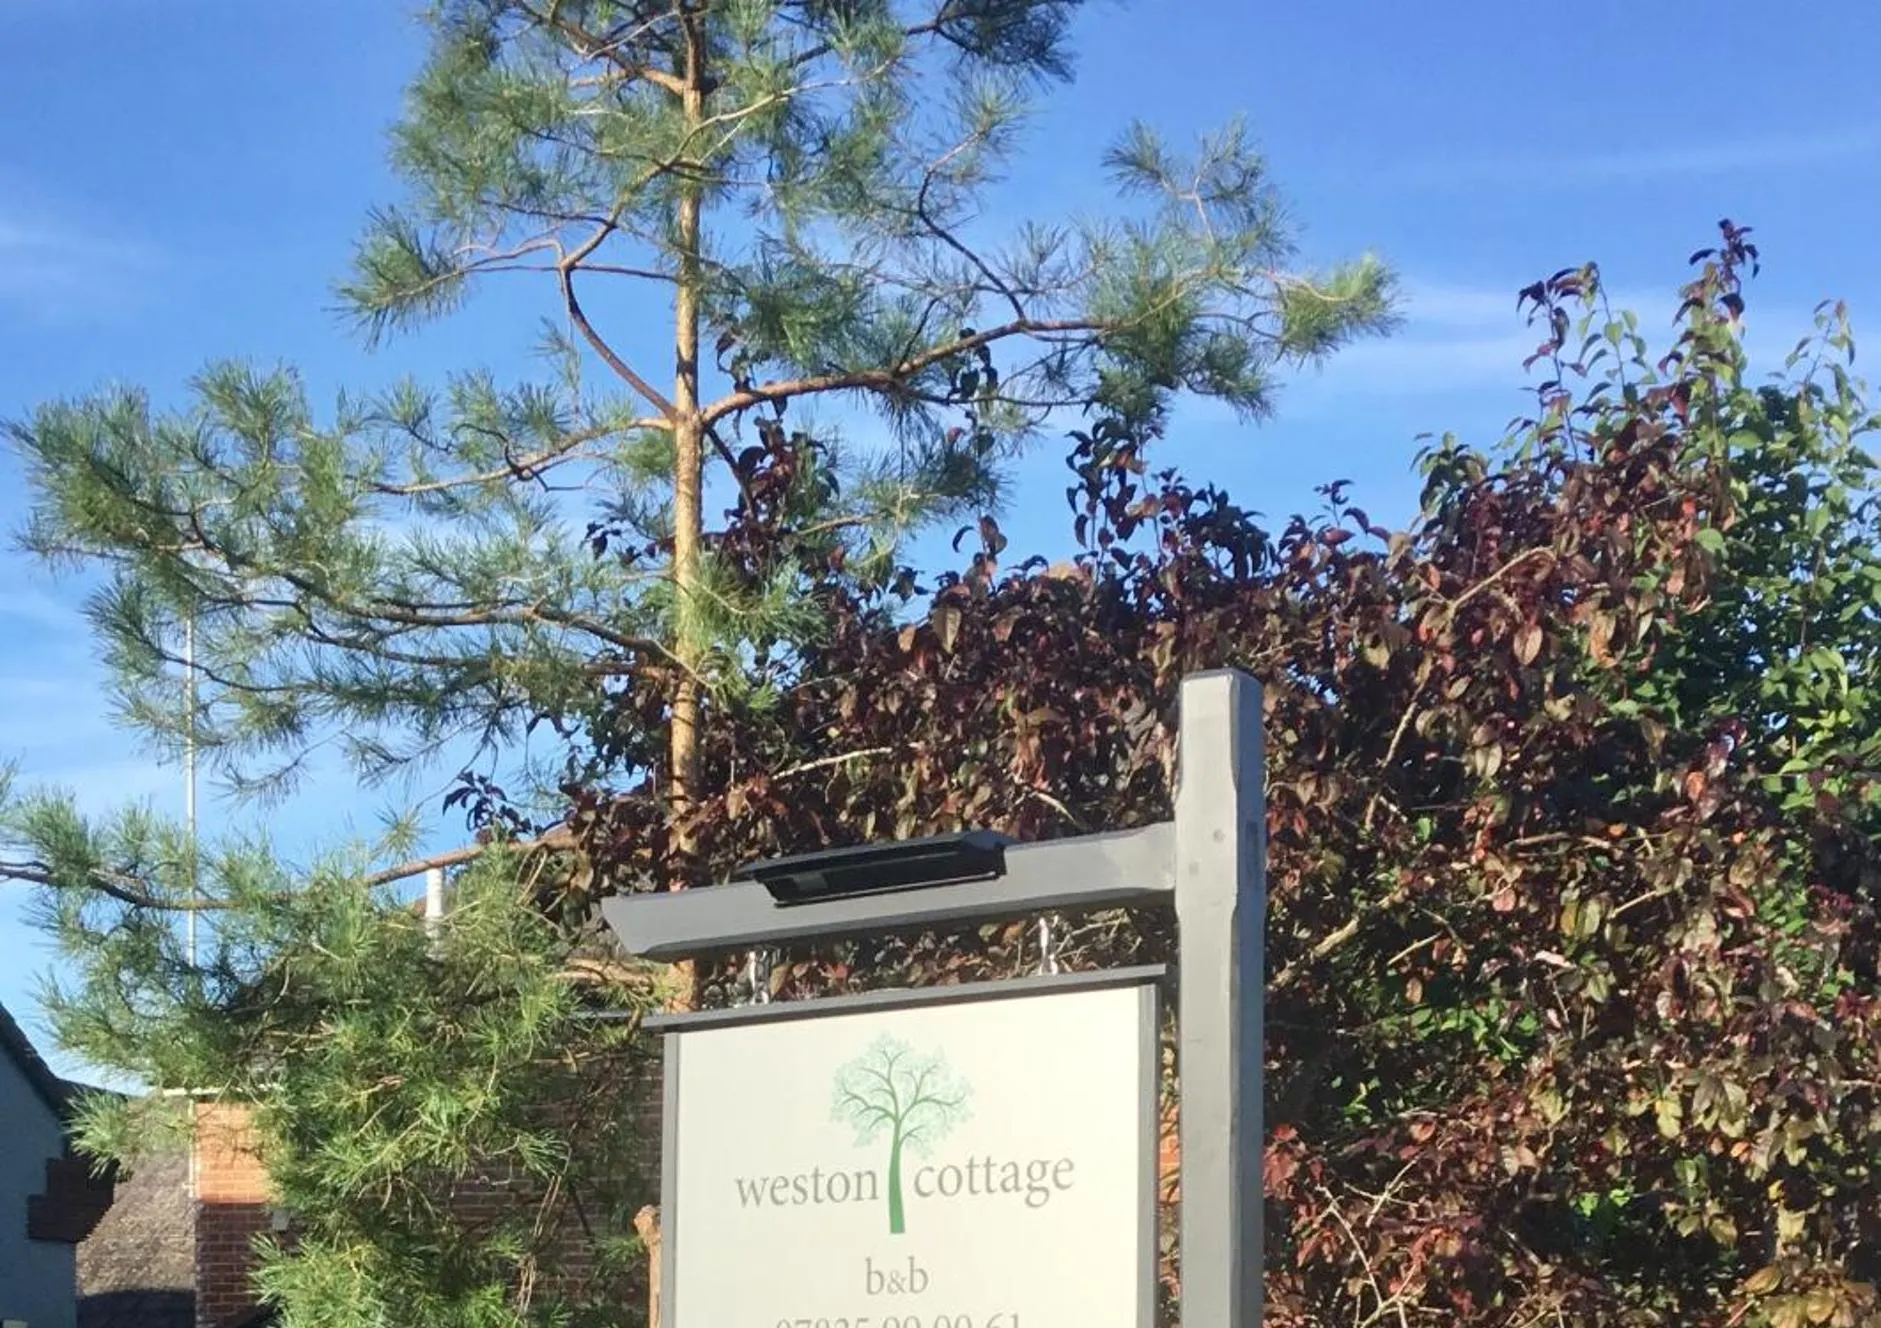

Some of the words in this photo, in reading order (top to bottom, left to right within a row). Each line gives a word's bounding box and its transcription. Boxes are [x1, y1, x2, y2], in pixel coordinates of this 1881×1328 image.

[735, 1165, 879, 1208] weston
[914, 1154, 1075, 1208] cottage
[865, 1255, 929, 1295] b&b
